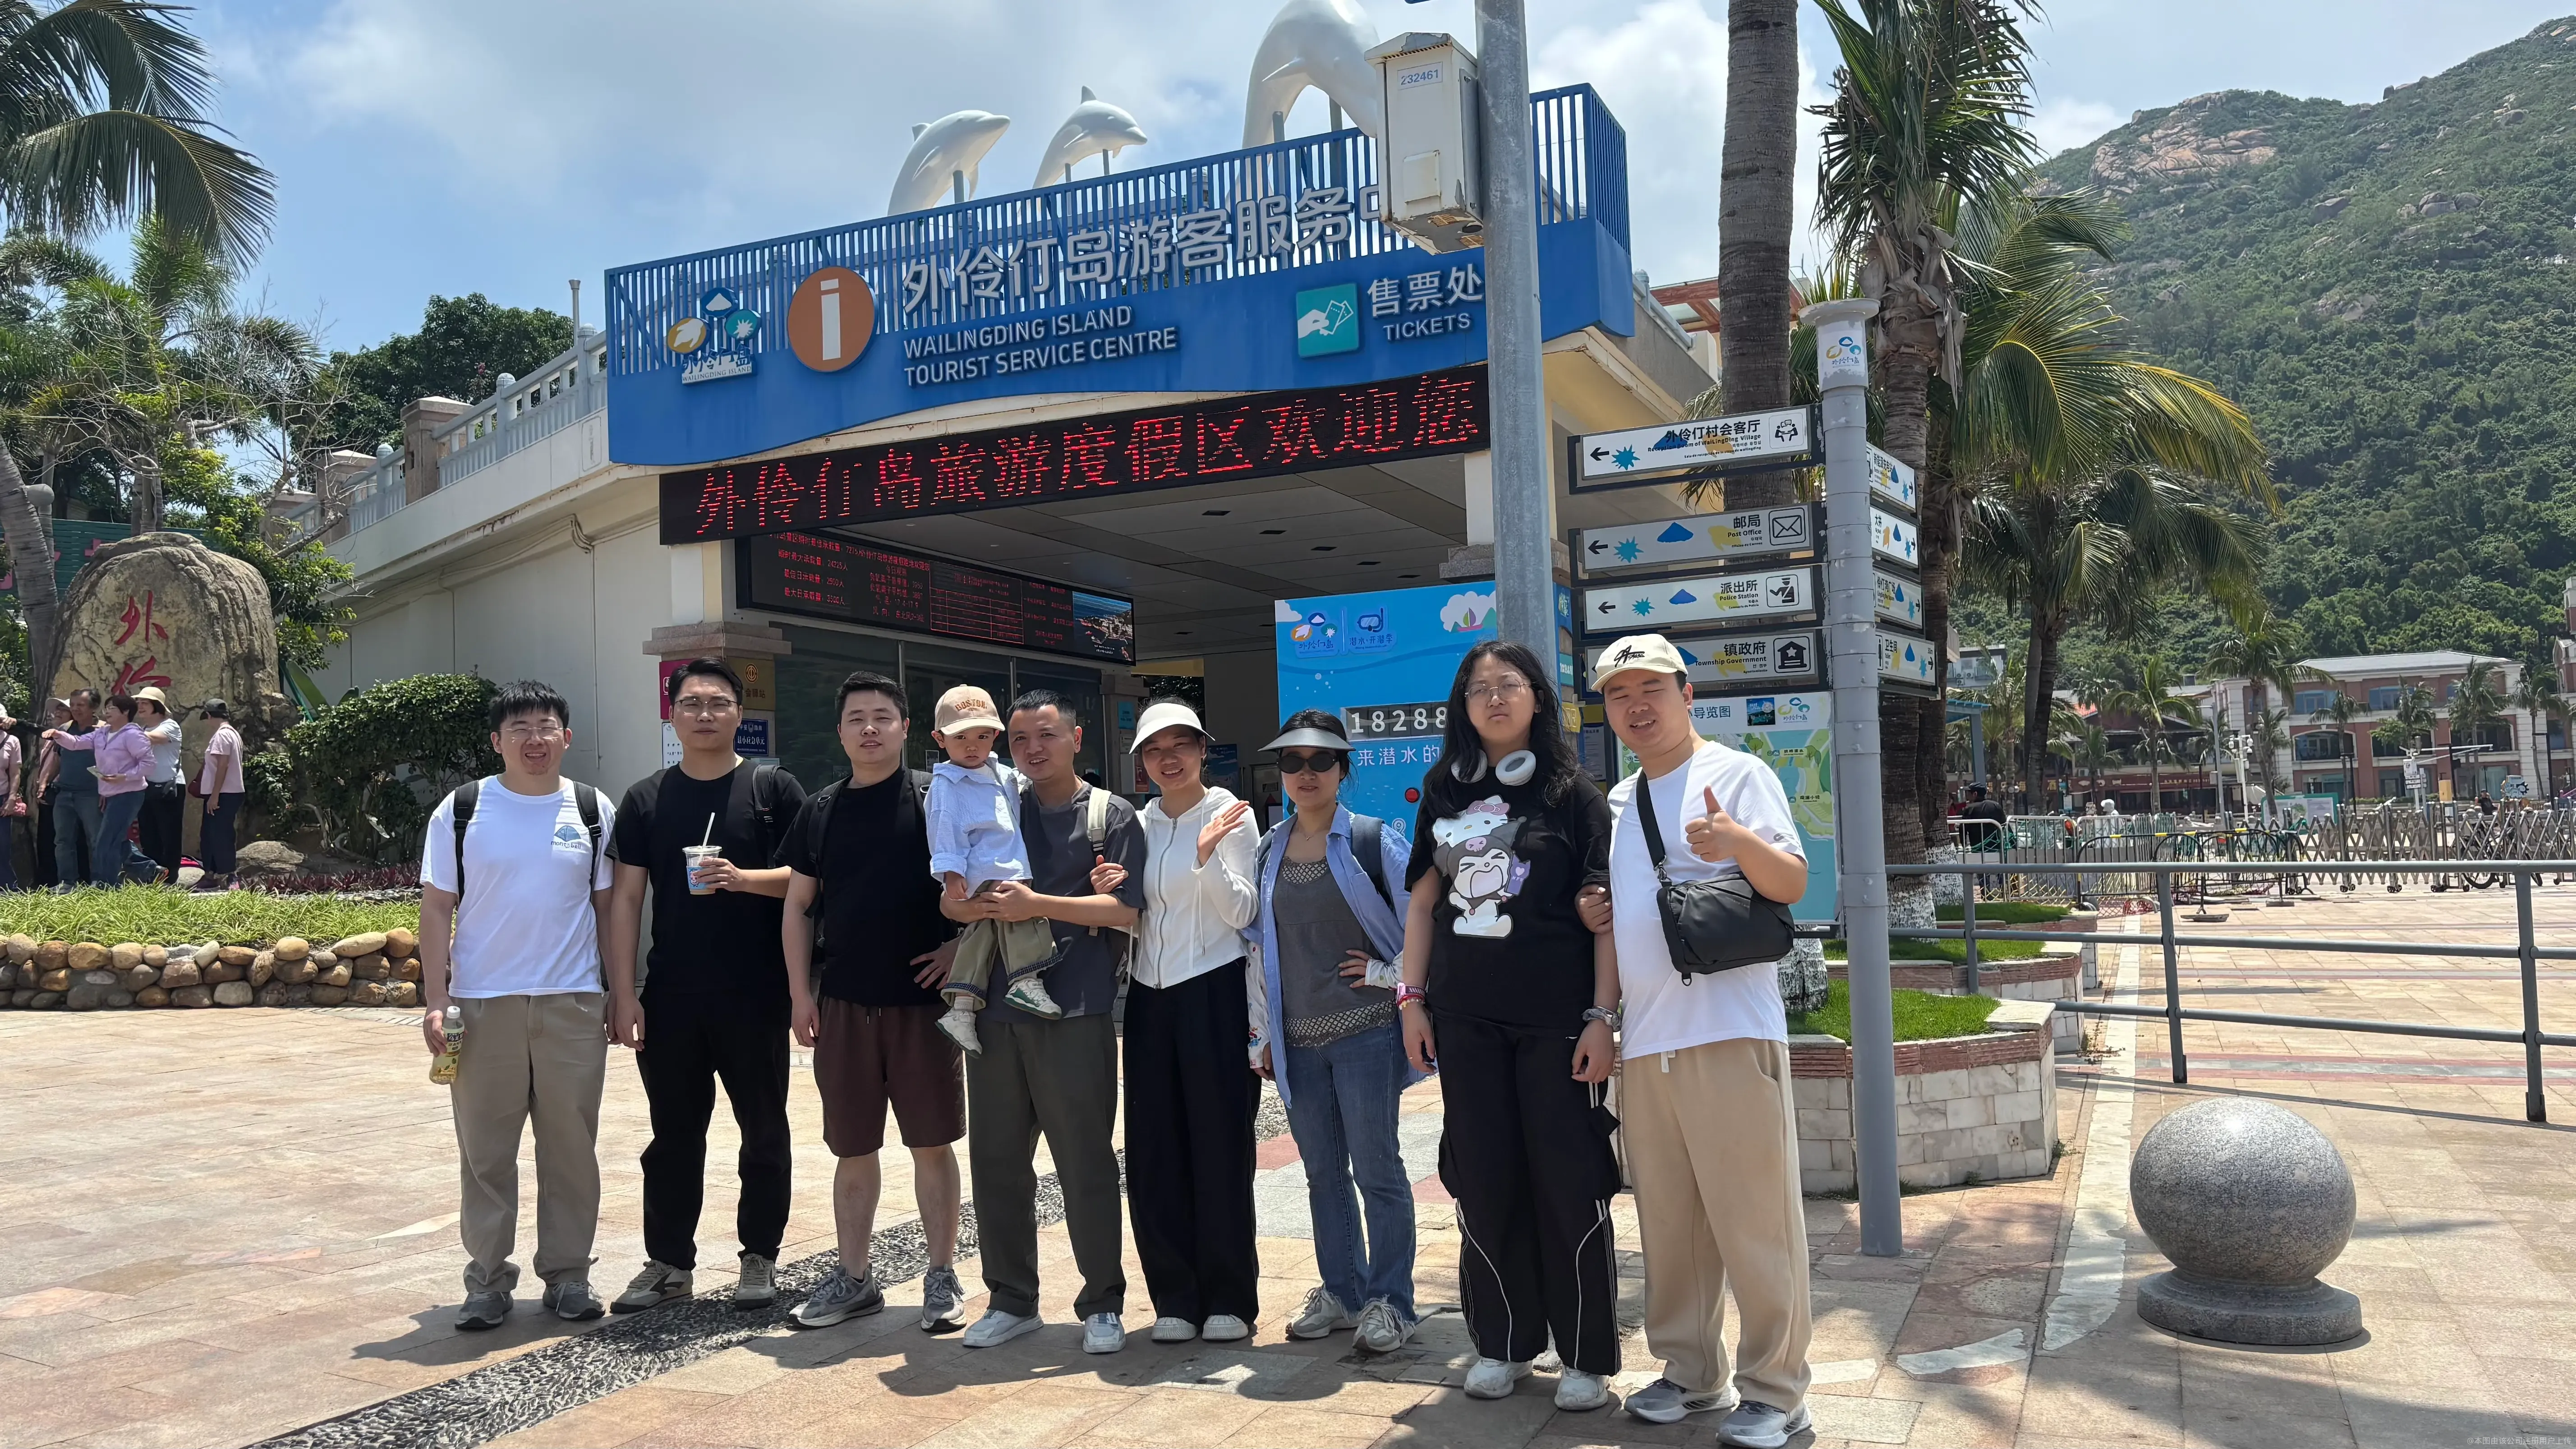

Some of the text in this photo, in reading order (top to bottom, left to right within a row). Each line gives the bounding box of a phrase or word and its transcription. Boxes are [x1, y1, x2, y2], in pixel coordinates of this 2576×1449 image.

[1400, 69, 1439, 86] 232461
[1367, 263, 1484, 318] 售票处
[903, 305, 1132, 361] WAILINGDING ISLAND
[1383, 312, 1471, 341] TICKETS
[903, 326, 1178, 387] TOURIST SERVICE CENTRE
[683, 366, 752, 382] WAILINGDING ISLAND
[1665, 419, 1761, 443] 外伶仃村会客厅
[696, 375, 1479, 535] 外伶仃岛旅游度假区欢迎您
[1733, 514, 1761, 529] 邮局
[1720, 580, 1758, 594] 派出所
[1724, 641, 1766, 657] 镇政府
[1885, 639, 1897, 653] 卫生间
[1695, 656, 1766, 667] Township Government
[743, 688, 766, 698] 会驿站
[1351, 707, 1447, 734] 18288
[1357, 745, 1440, 767] 来潜水的
